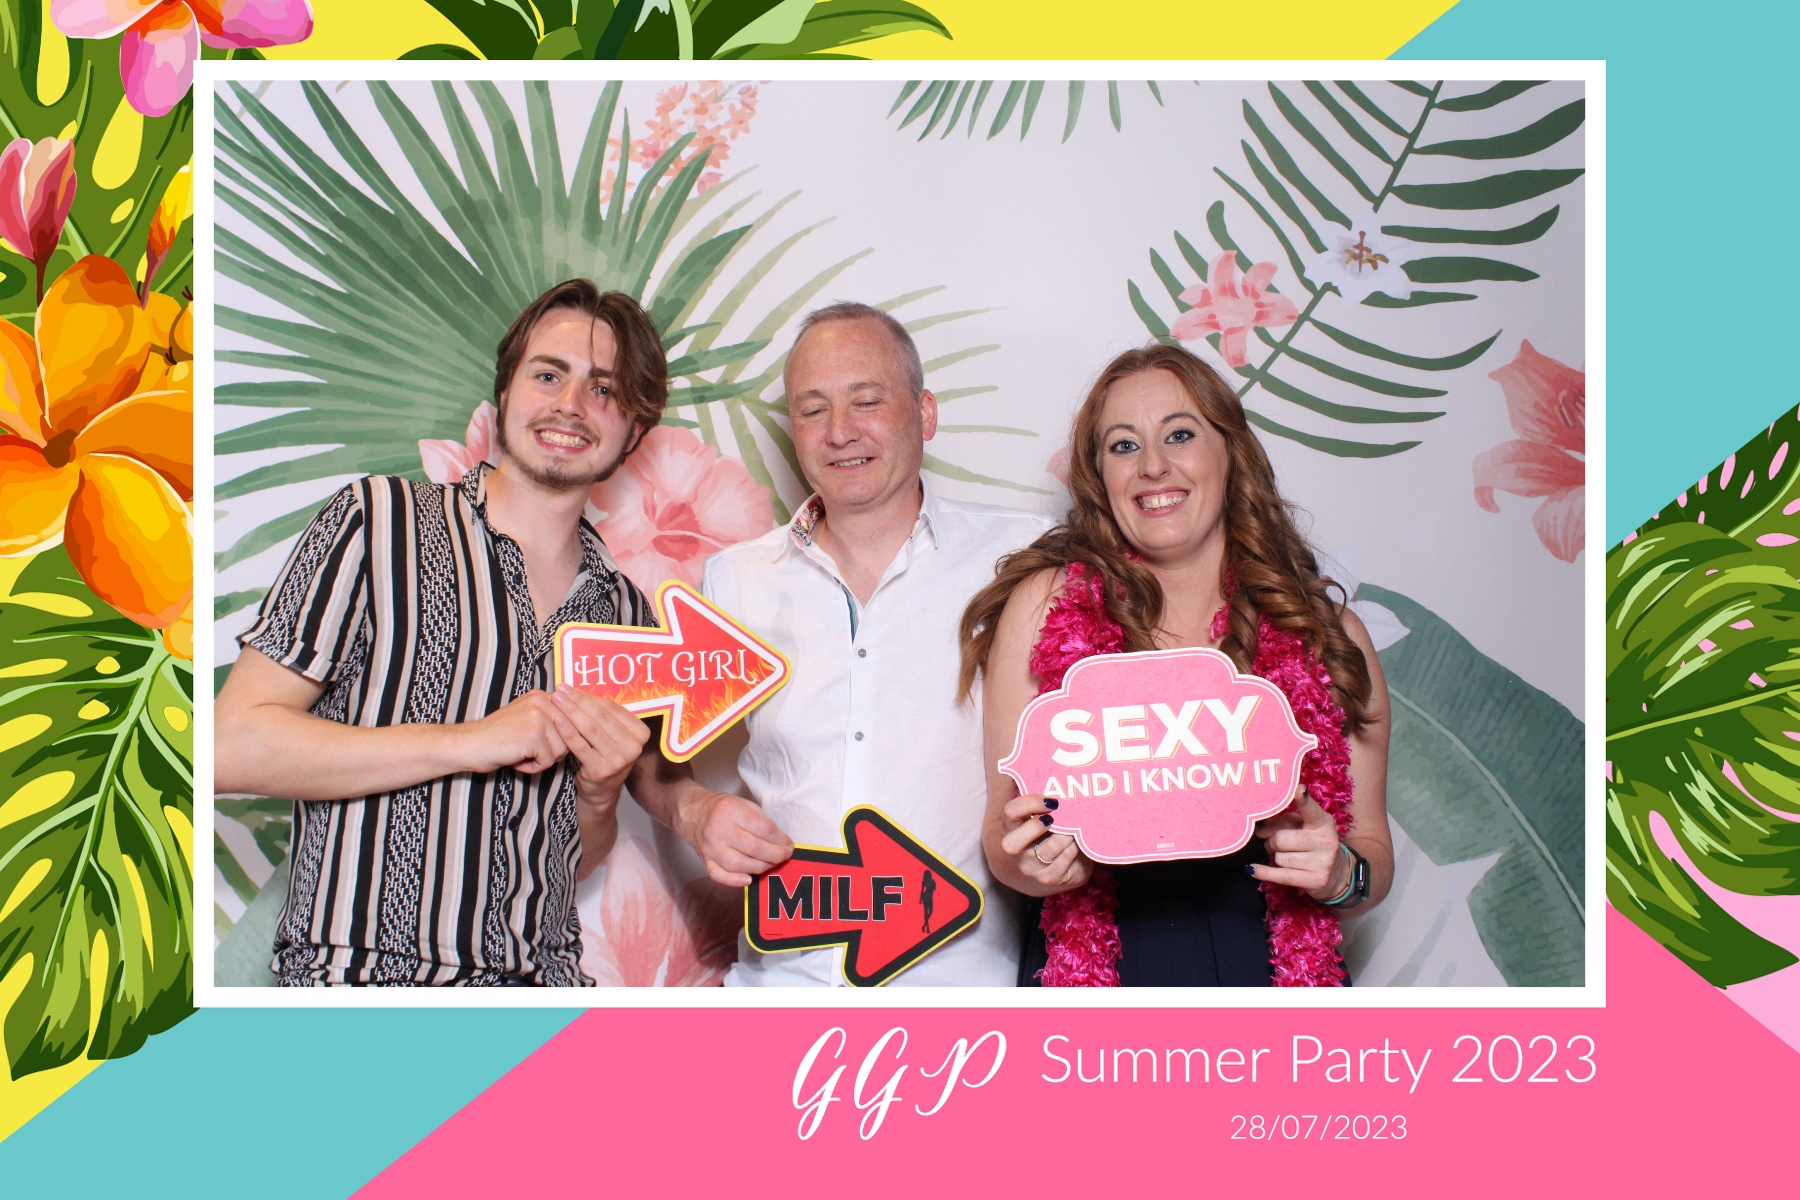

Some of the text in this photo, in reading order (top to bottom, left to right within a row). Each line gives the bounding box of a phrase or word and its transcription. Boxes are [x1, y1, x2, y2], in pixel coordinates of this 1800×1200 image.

[574, 649, 759, 687] HOT GIRL
[1050, 695, 1262, 768] SEXY
[1043, 758, 1283, 800] AND I KNOW IT
[767, 874, 904, 922] MILF
